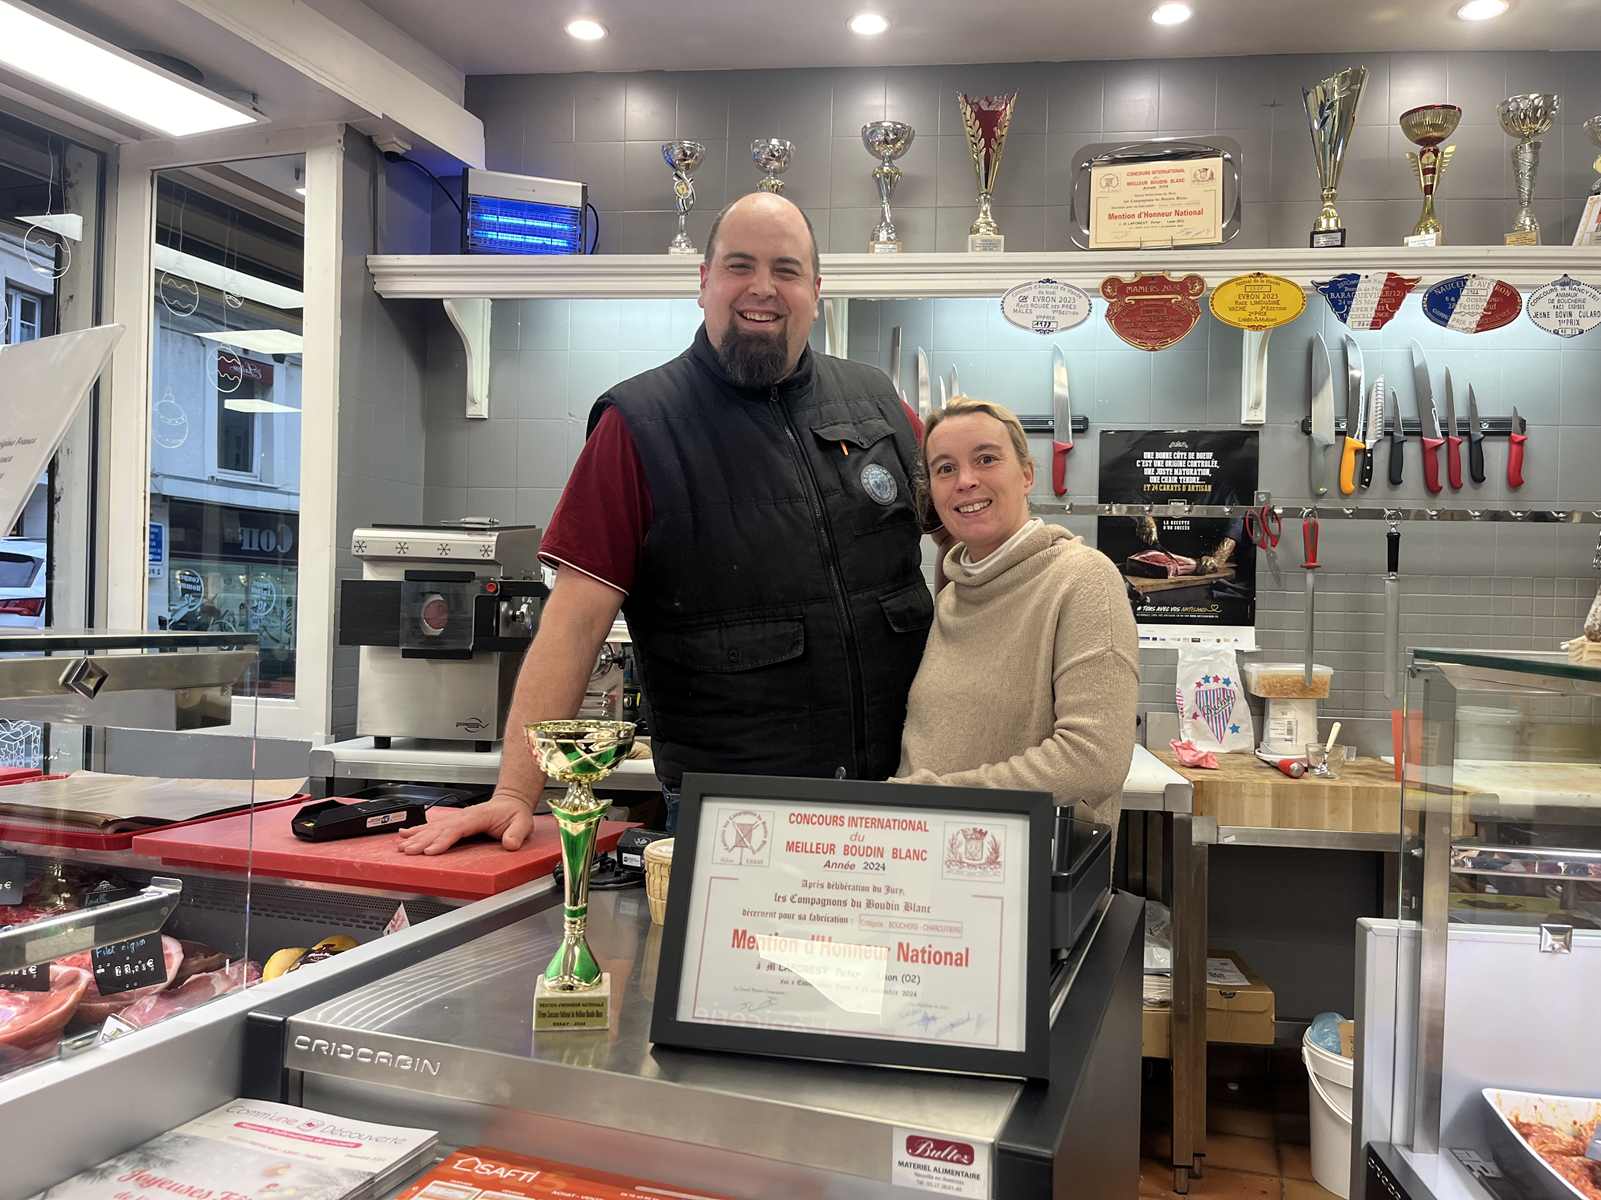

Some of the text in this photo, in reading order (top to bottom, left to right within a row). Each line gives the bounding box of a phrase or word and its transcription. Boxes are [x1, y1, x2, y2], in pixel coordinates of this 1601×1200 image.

[1108, 208, 1204, 221] Mention d'Honneur National
[1182, 484, 1212, 492] D'ARTISAN
[788, 812, 930, 833] CONCOURS INTERNATIONAL
[850, 831, 865, 843] du
[785, 840, 929, 862] MEILLEUR BOUDIN BLANC
[823, 859, 887, 873] Année 2024
[801, 879, 825, 891] Après
[872, 884, 883, 895] du
[789, 893, 848, 909] Compagnons
[851, 896, 864, 909] du
[865, 898, 901, 912] Boudin
[904, 901, 932, 915] Blanc
[741, 908, 776, 921] décernent
[778, 909, 796, 922] pour
[797, 912, 808, 922] sa
[808, 911, 849, 925] fabrication
[731, 928, 970, 969] Mention d'Honneur National
[901, 973, 921, 985] (02)
[293, 1034, 442, 1077] CRIOCABIN
[319, 1121, 408, 1147] Découverte
[476, 1162, 541, 1185] SAFTI
[897, 1160, 981, 1181] MATERIEL ALIMENTAIRE
